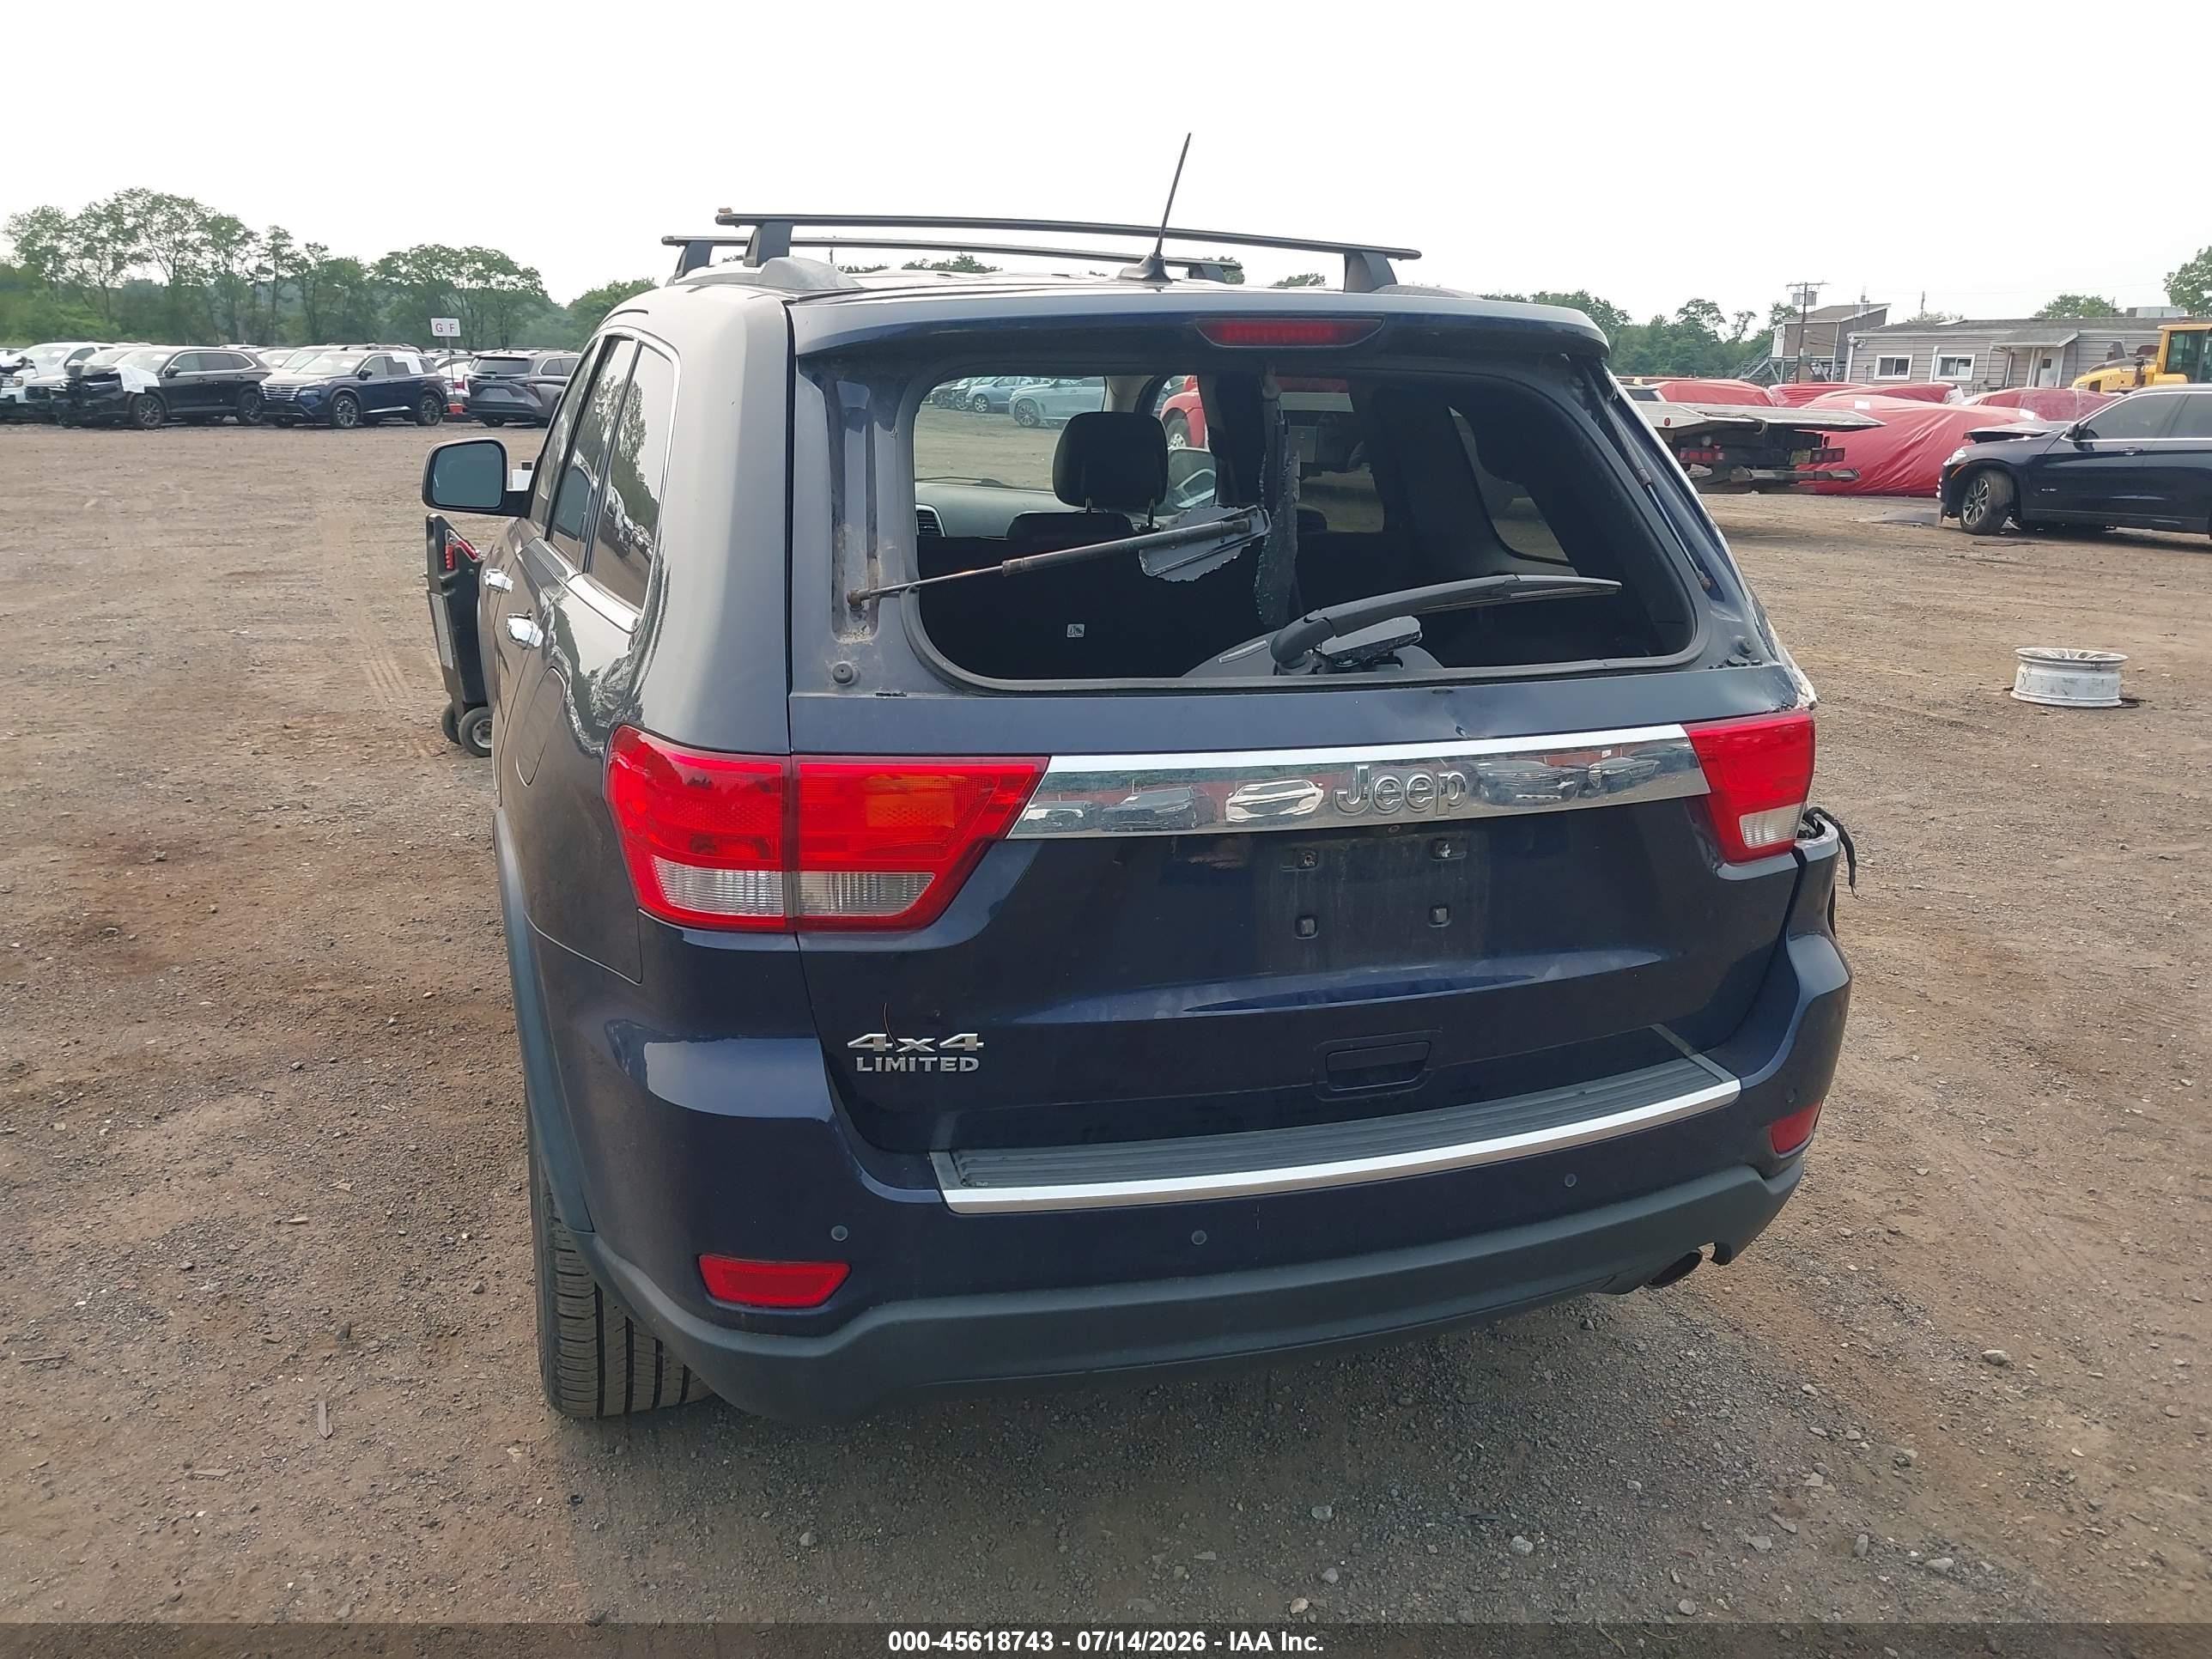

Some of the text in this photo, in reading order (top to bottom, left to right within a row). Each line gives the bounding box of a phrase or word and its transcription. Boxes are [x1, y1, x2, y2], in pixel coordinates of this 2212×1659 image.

[435, 323, 455, 332] G F
[1334, 764, 1468, 817] Jeep
[847, 1033, 985, 1052] 4x4
[856, 1056, 980, 1072] LIMITED
